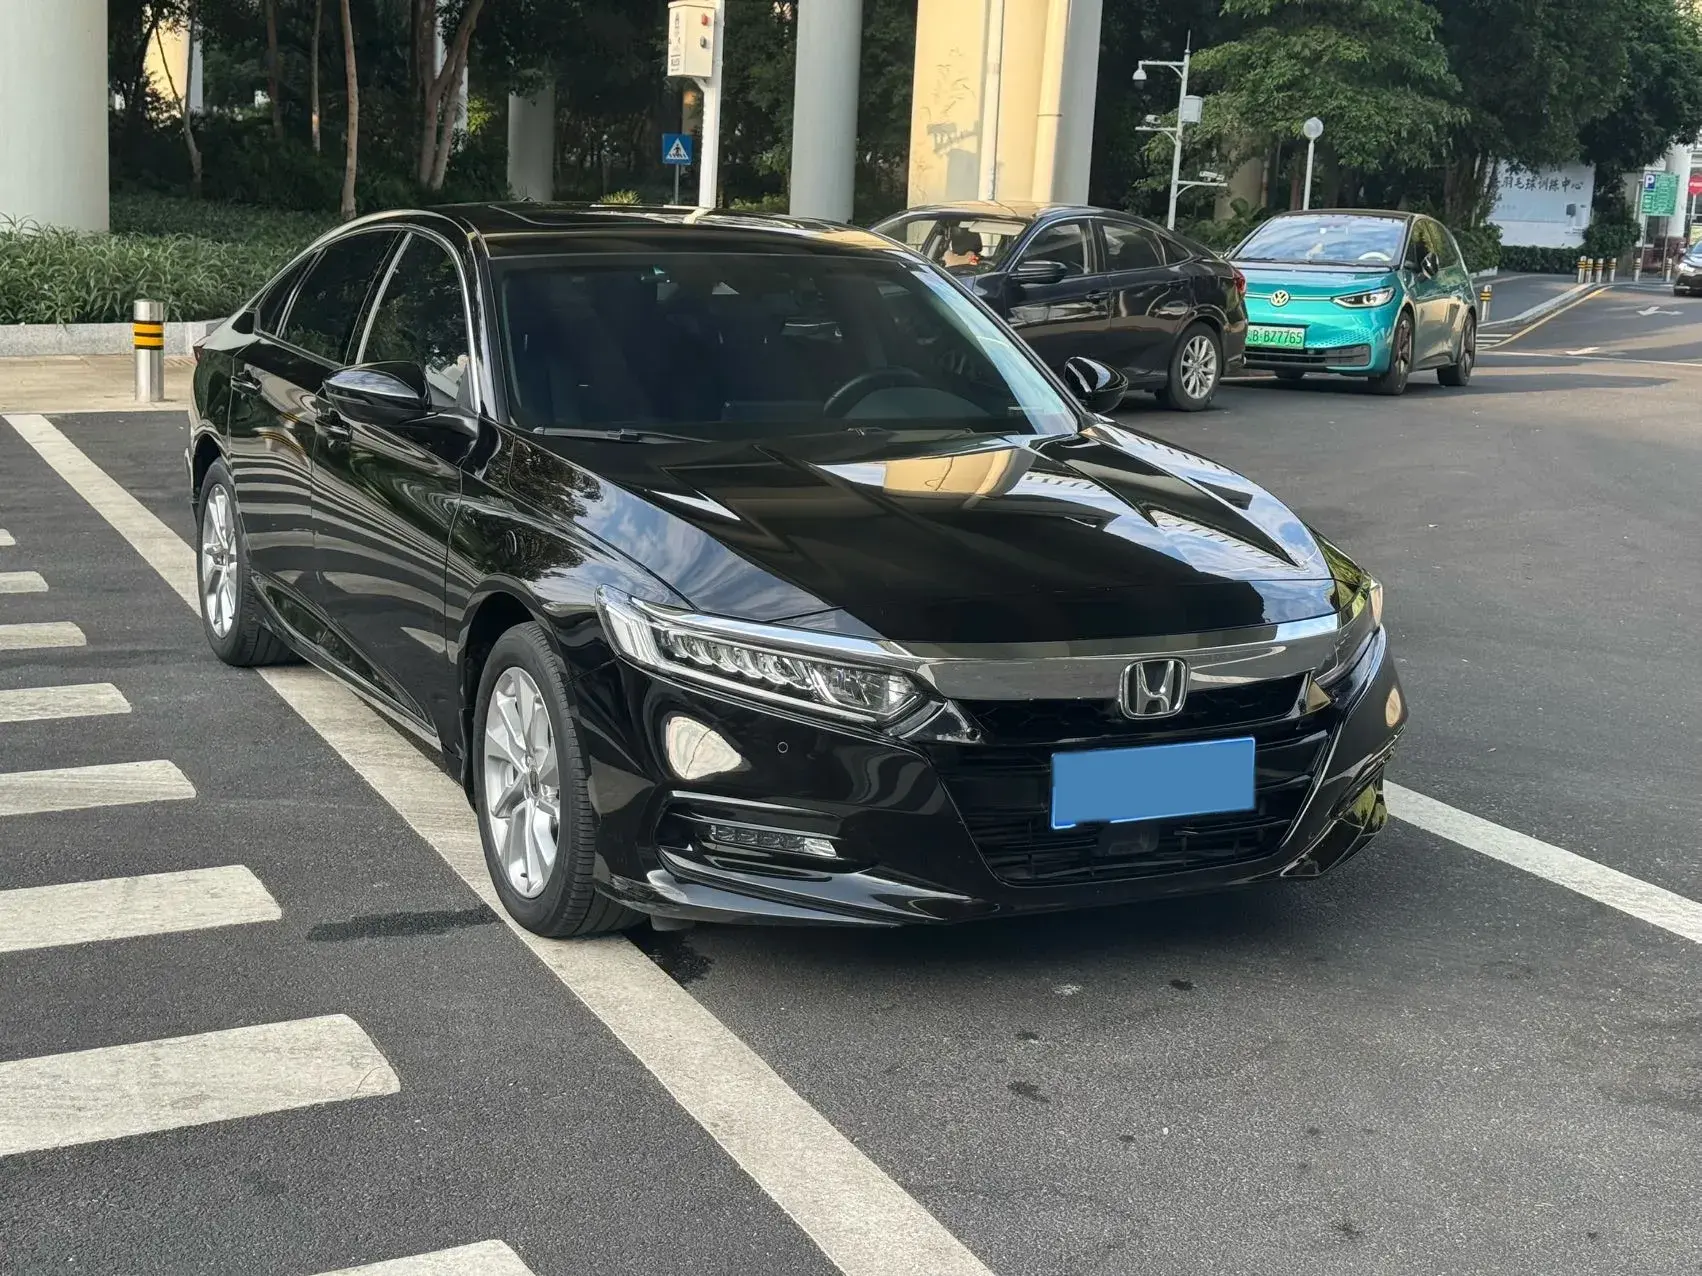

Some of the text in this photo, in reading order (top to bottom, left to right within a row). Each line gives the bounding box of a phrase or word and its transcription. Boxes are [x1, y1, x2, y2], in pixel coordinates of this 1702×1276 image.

[1495, 176, 1584, 192] 羽毛球训练中心
[1645, 174, 1655, 188] P
